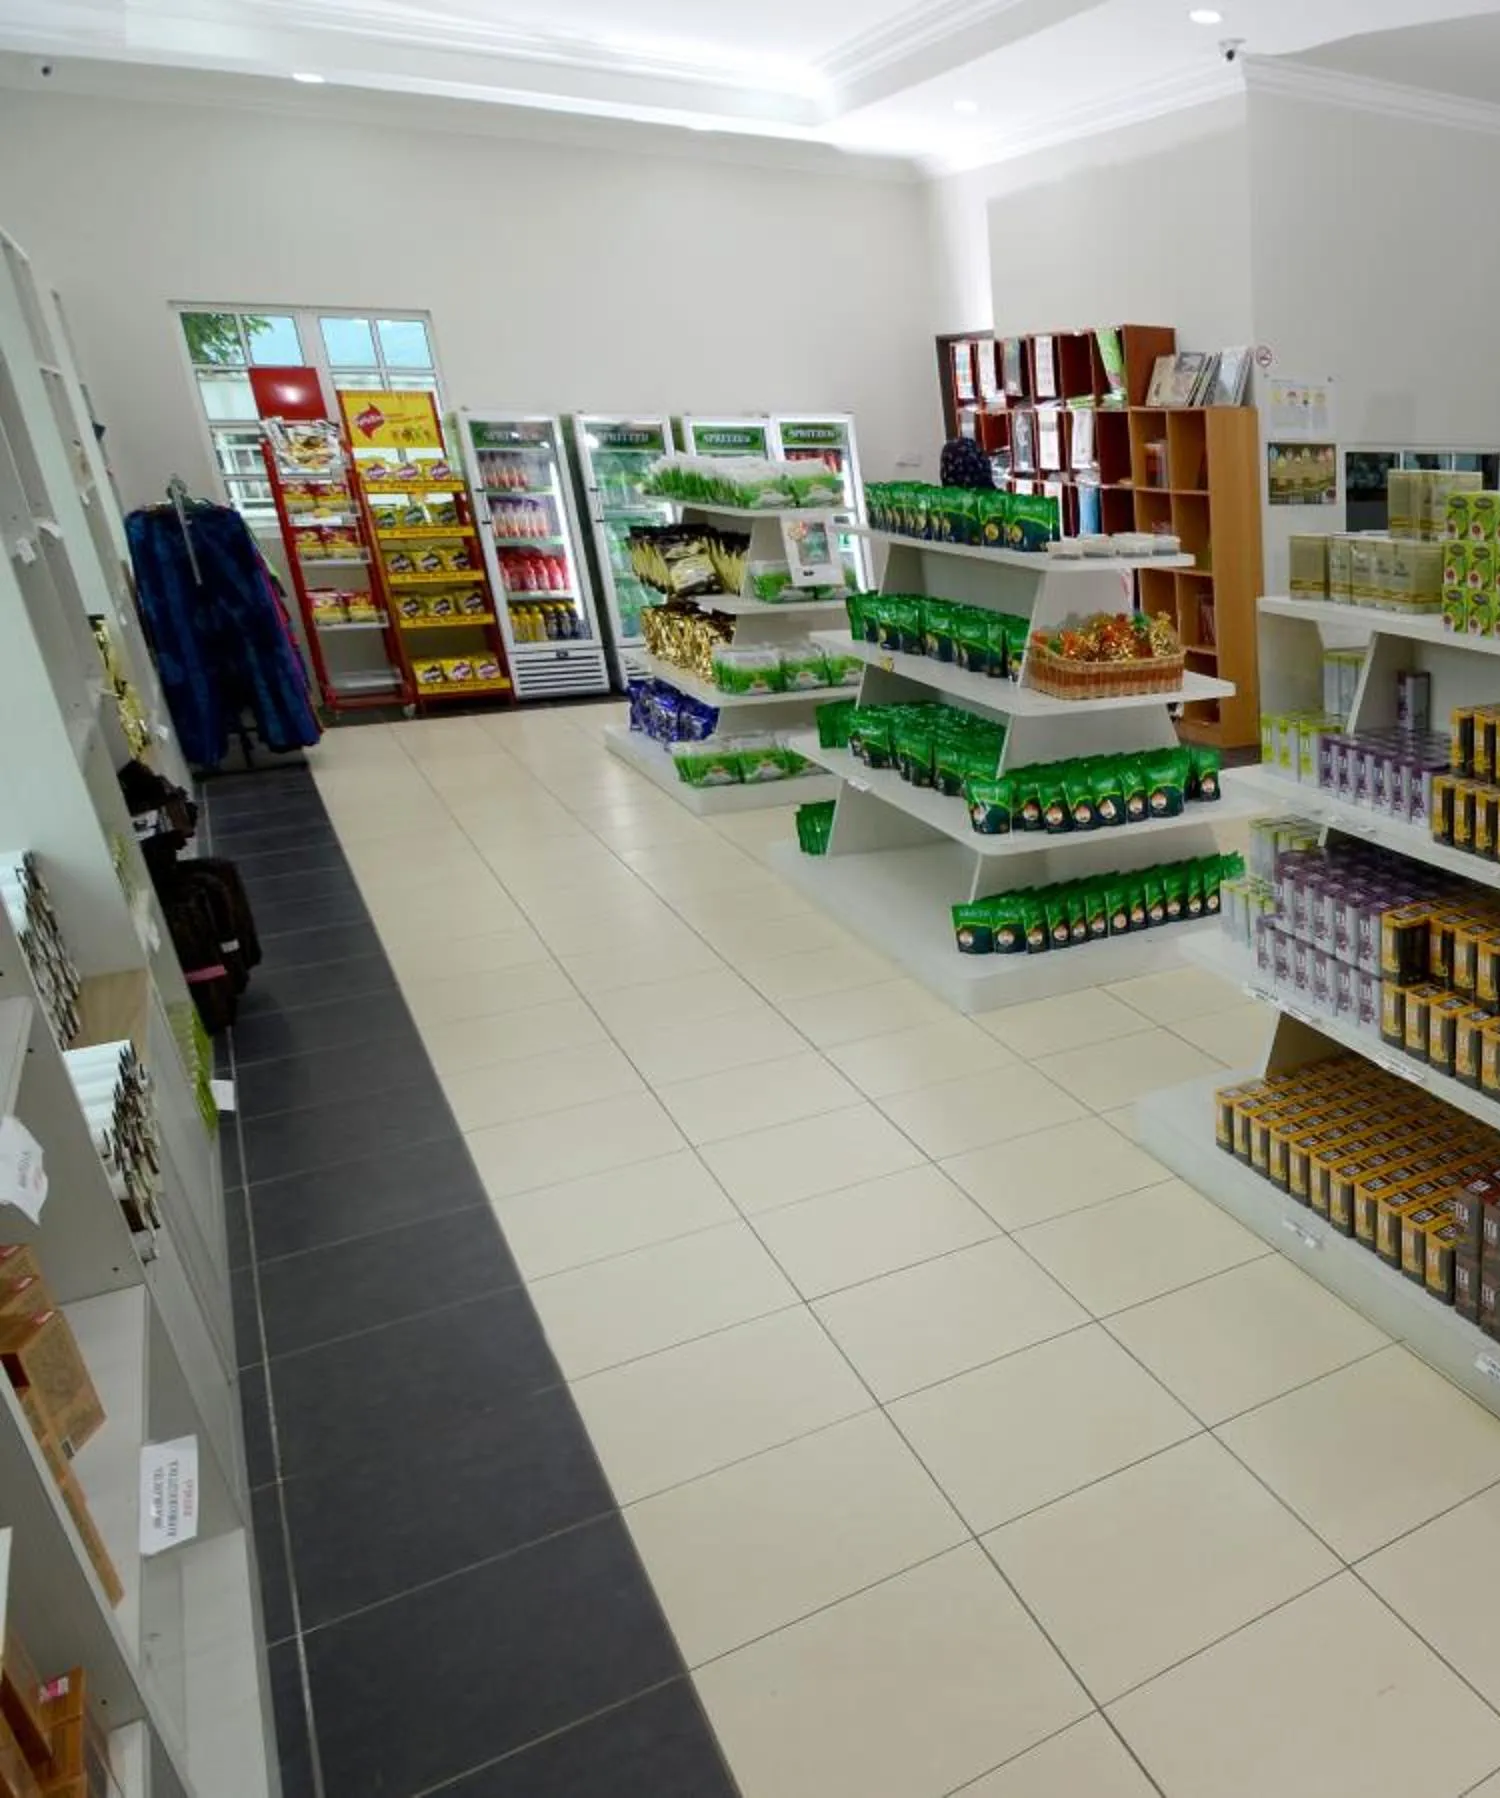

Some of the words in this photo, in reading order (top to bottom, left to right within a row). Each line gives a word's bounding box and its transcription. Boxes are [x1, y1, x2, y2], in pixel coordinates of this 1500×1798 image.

[1484, 1218, 1497, 1238] TEA
[1456, 1266, 1469, 1286] TEA
[1481, 1284, 1495, 1304] TEA
